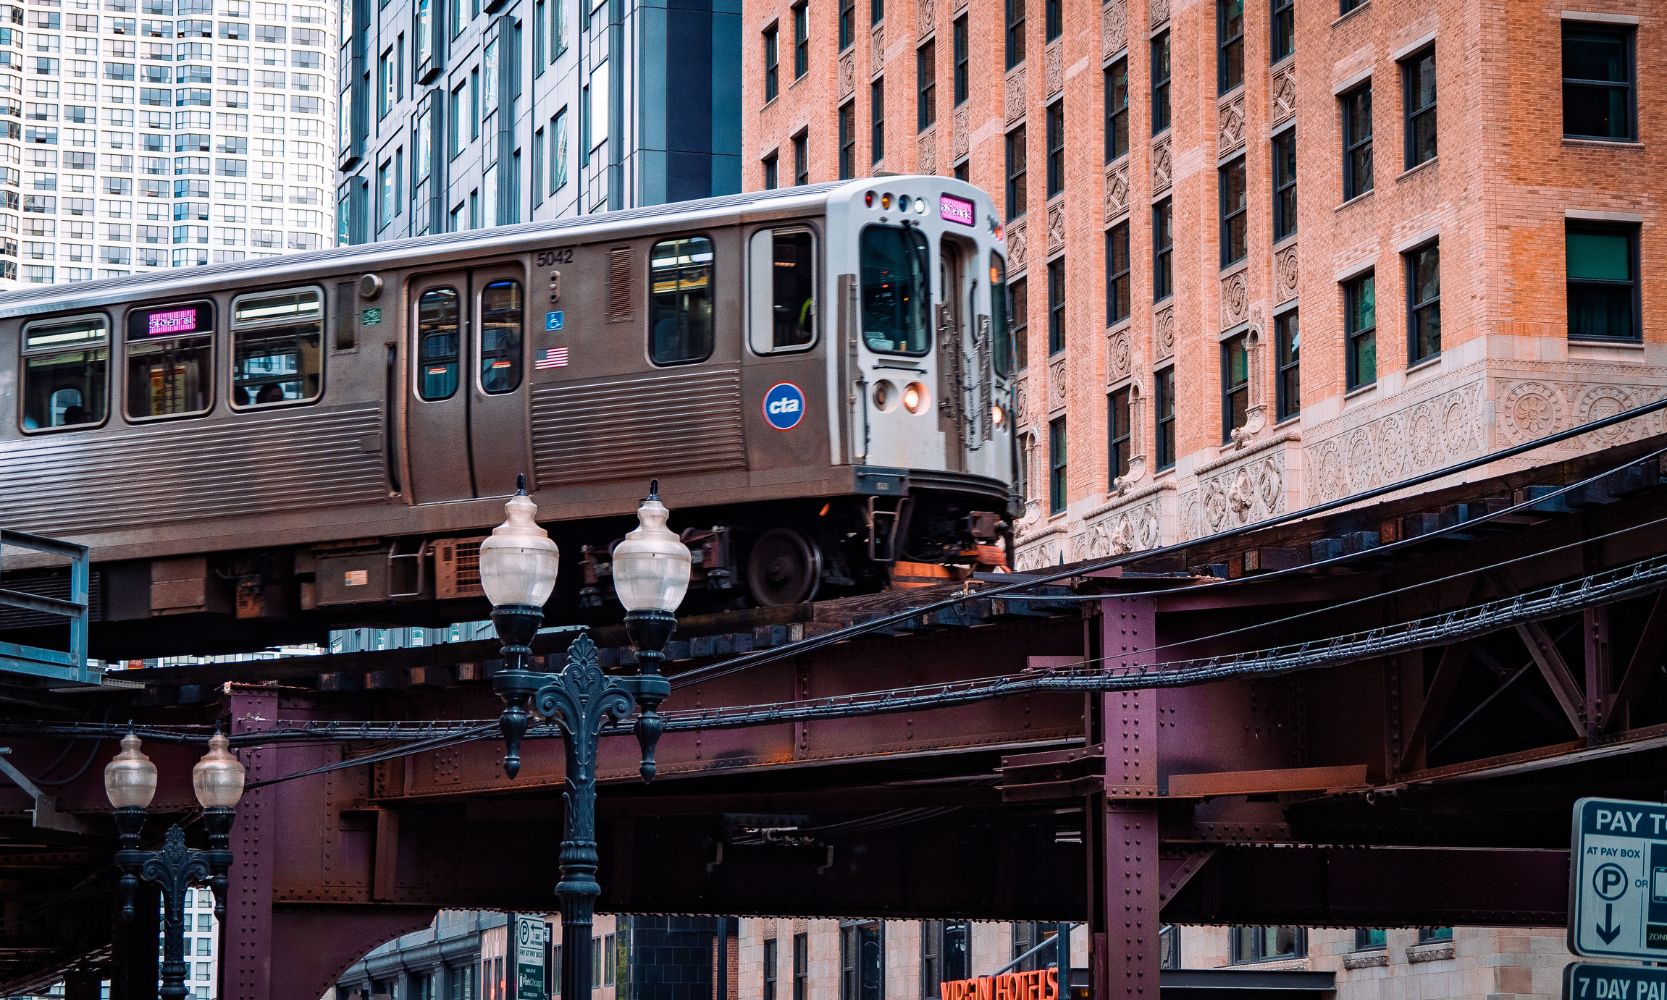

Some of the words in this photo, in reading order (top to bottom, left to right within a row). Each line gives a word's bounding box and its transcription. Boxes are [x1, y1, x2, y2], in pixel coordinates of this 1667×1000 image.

[536, 250, 574, 267] 5042
[769, 397, 800, 415] cta
[1596, 809, 1643, 833] PAY
[1649, 813, 1667, 834] T
[1587, 846, 1598, 855] AT
[1600, 847, 1618, 857] PAY
[1621, 848, 1641, 859] BOX
[1634, 879, 1649, 889] OR
[1648, 932, 1667, 942] ZON
[940, 976, 993, 1000] VIRGIN
[996, 967, 1058, 1000] HOTELS
[1579, 977, 1590, 997] 7
[1596, 978, 1630, 1000] DAY
